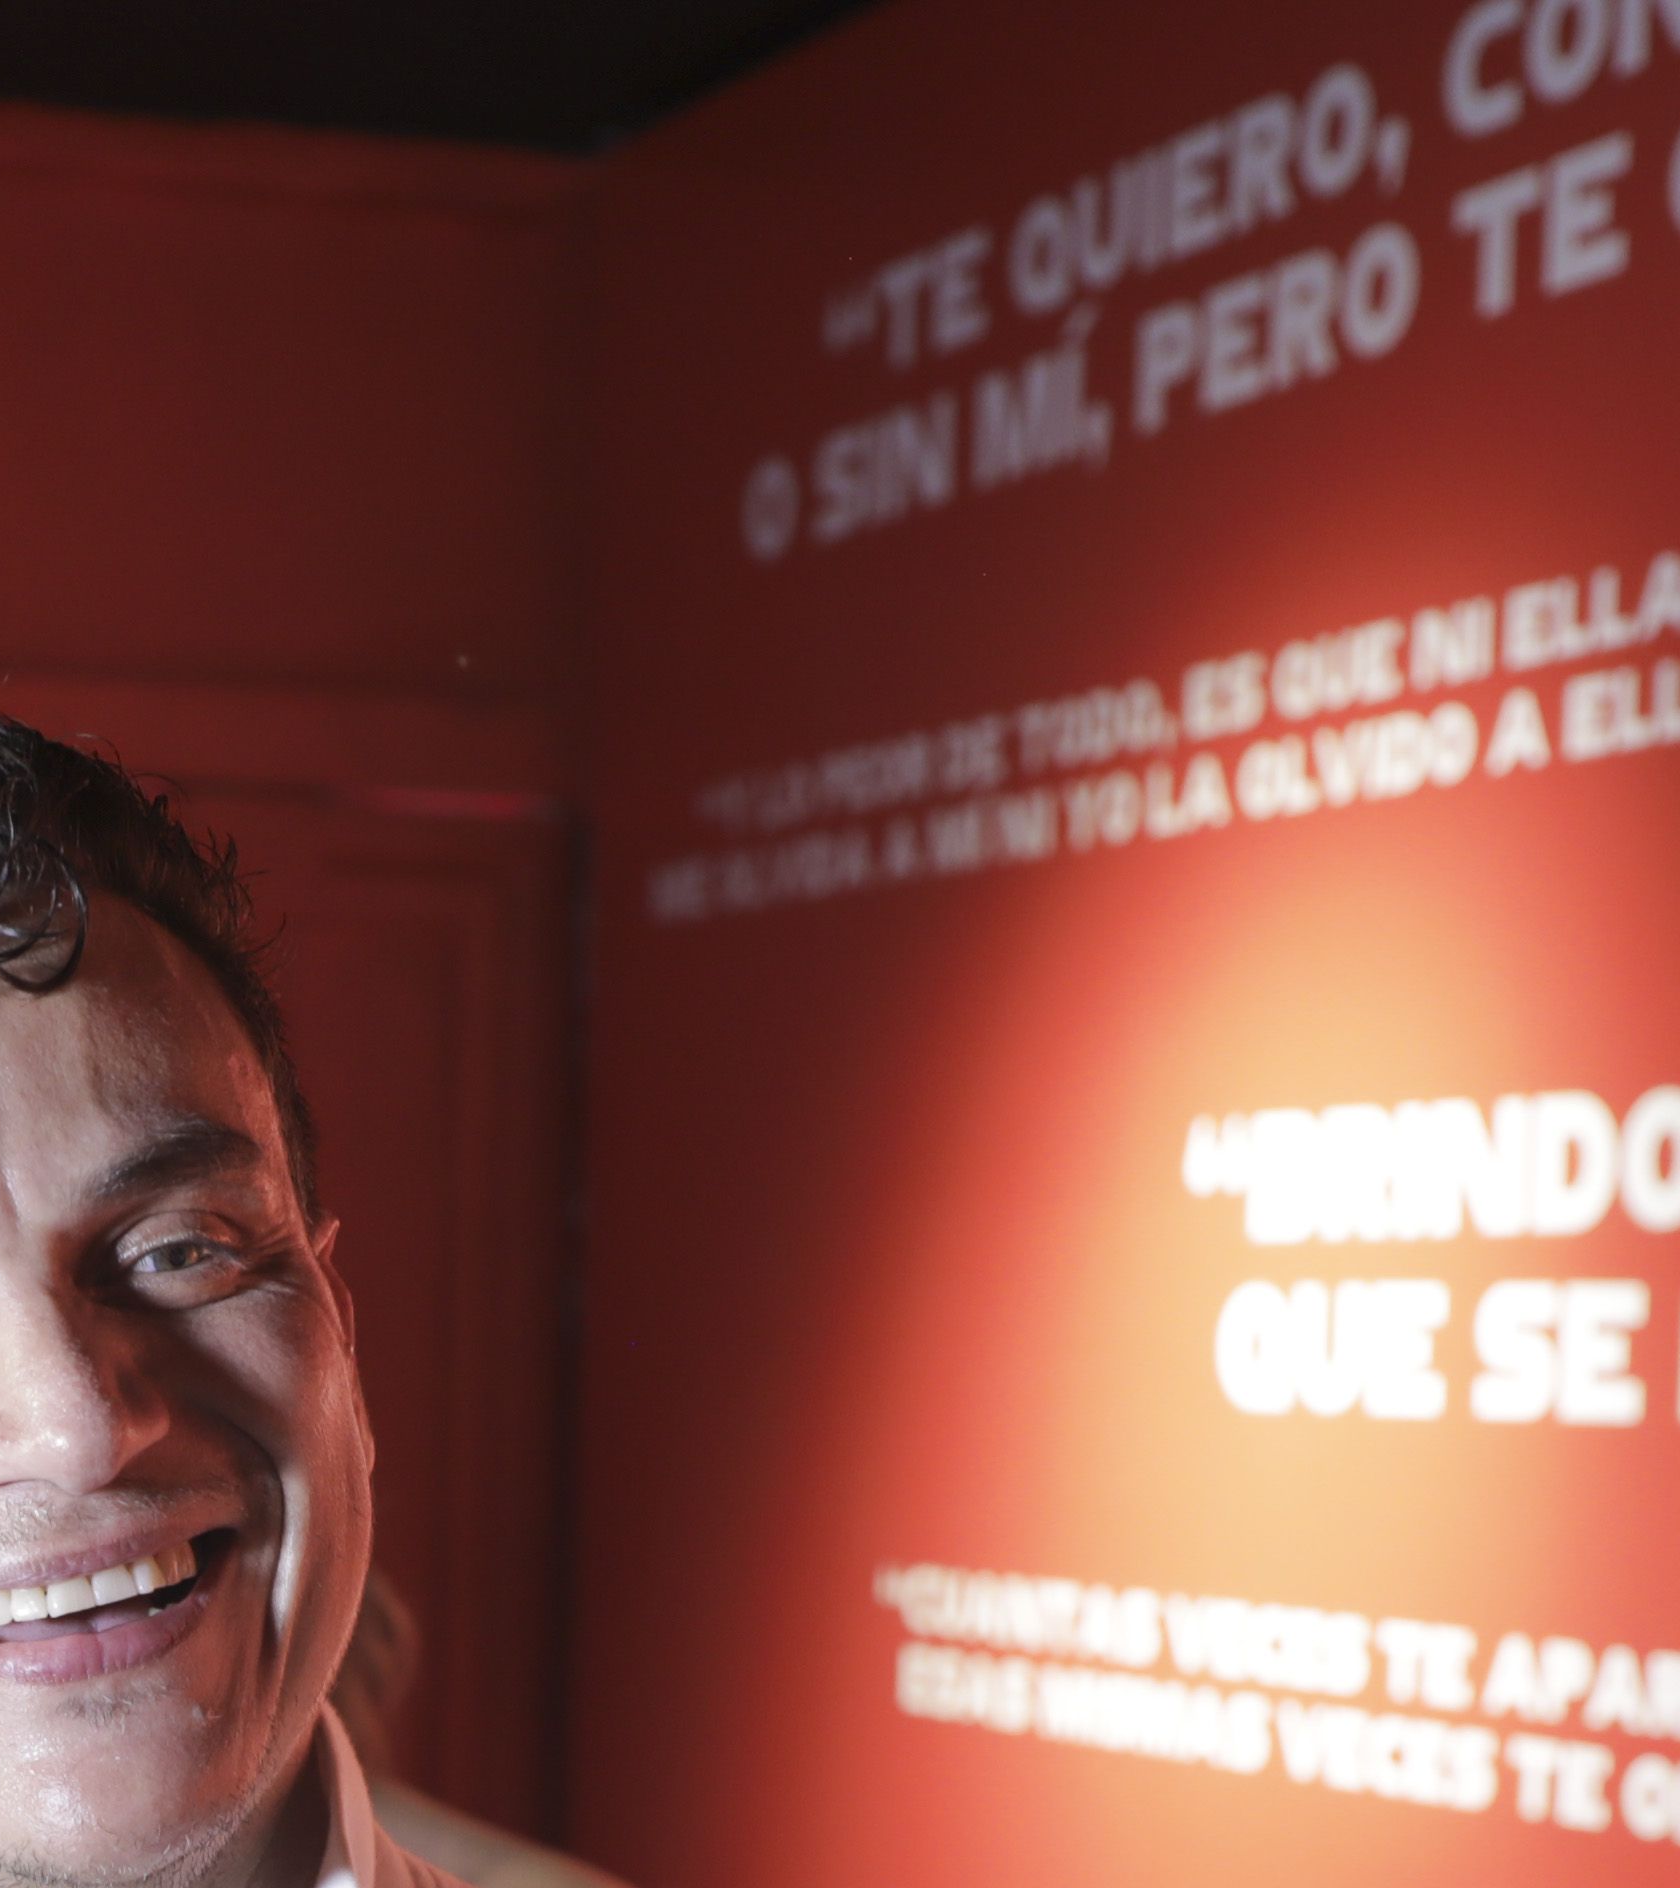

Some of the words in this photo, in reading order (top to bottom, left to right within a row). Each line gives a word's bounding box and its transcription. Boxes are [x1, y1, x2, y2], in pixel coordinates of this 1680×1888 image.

[1008, 62, 1410, 315] QUIERO,
[743, 455, 800, 563] O
[810, 390, 958, 543] SIN
[1135, 222, 1420, 437] PERO
[1451, 130, 1633, 320] TE
[1181, 650, 1267, 742] ES
[1270, 615, 1405, 720] QUE
[1408, 594, 1497, 692] NI
[1144, 750, 1232, 842] LA
[1235, 698, 1480, 822] OLVIDO
[1483, 685, 1552, 778] A
[1214, 1278, 1448, 1425] QUE
[1471, 1280, 1647, 1430] SE
[1374, 1613, 1477, 1713] TE
[1275, 1695, 1499, 1816] VECES
[1504, 1730, 1614, 1831] TE
